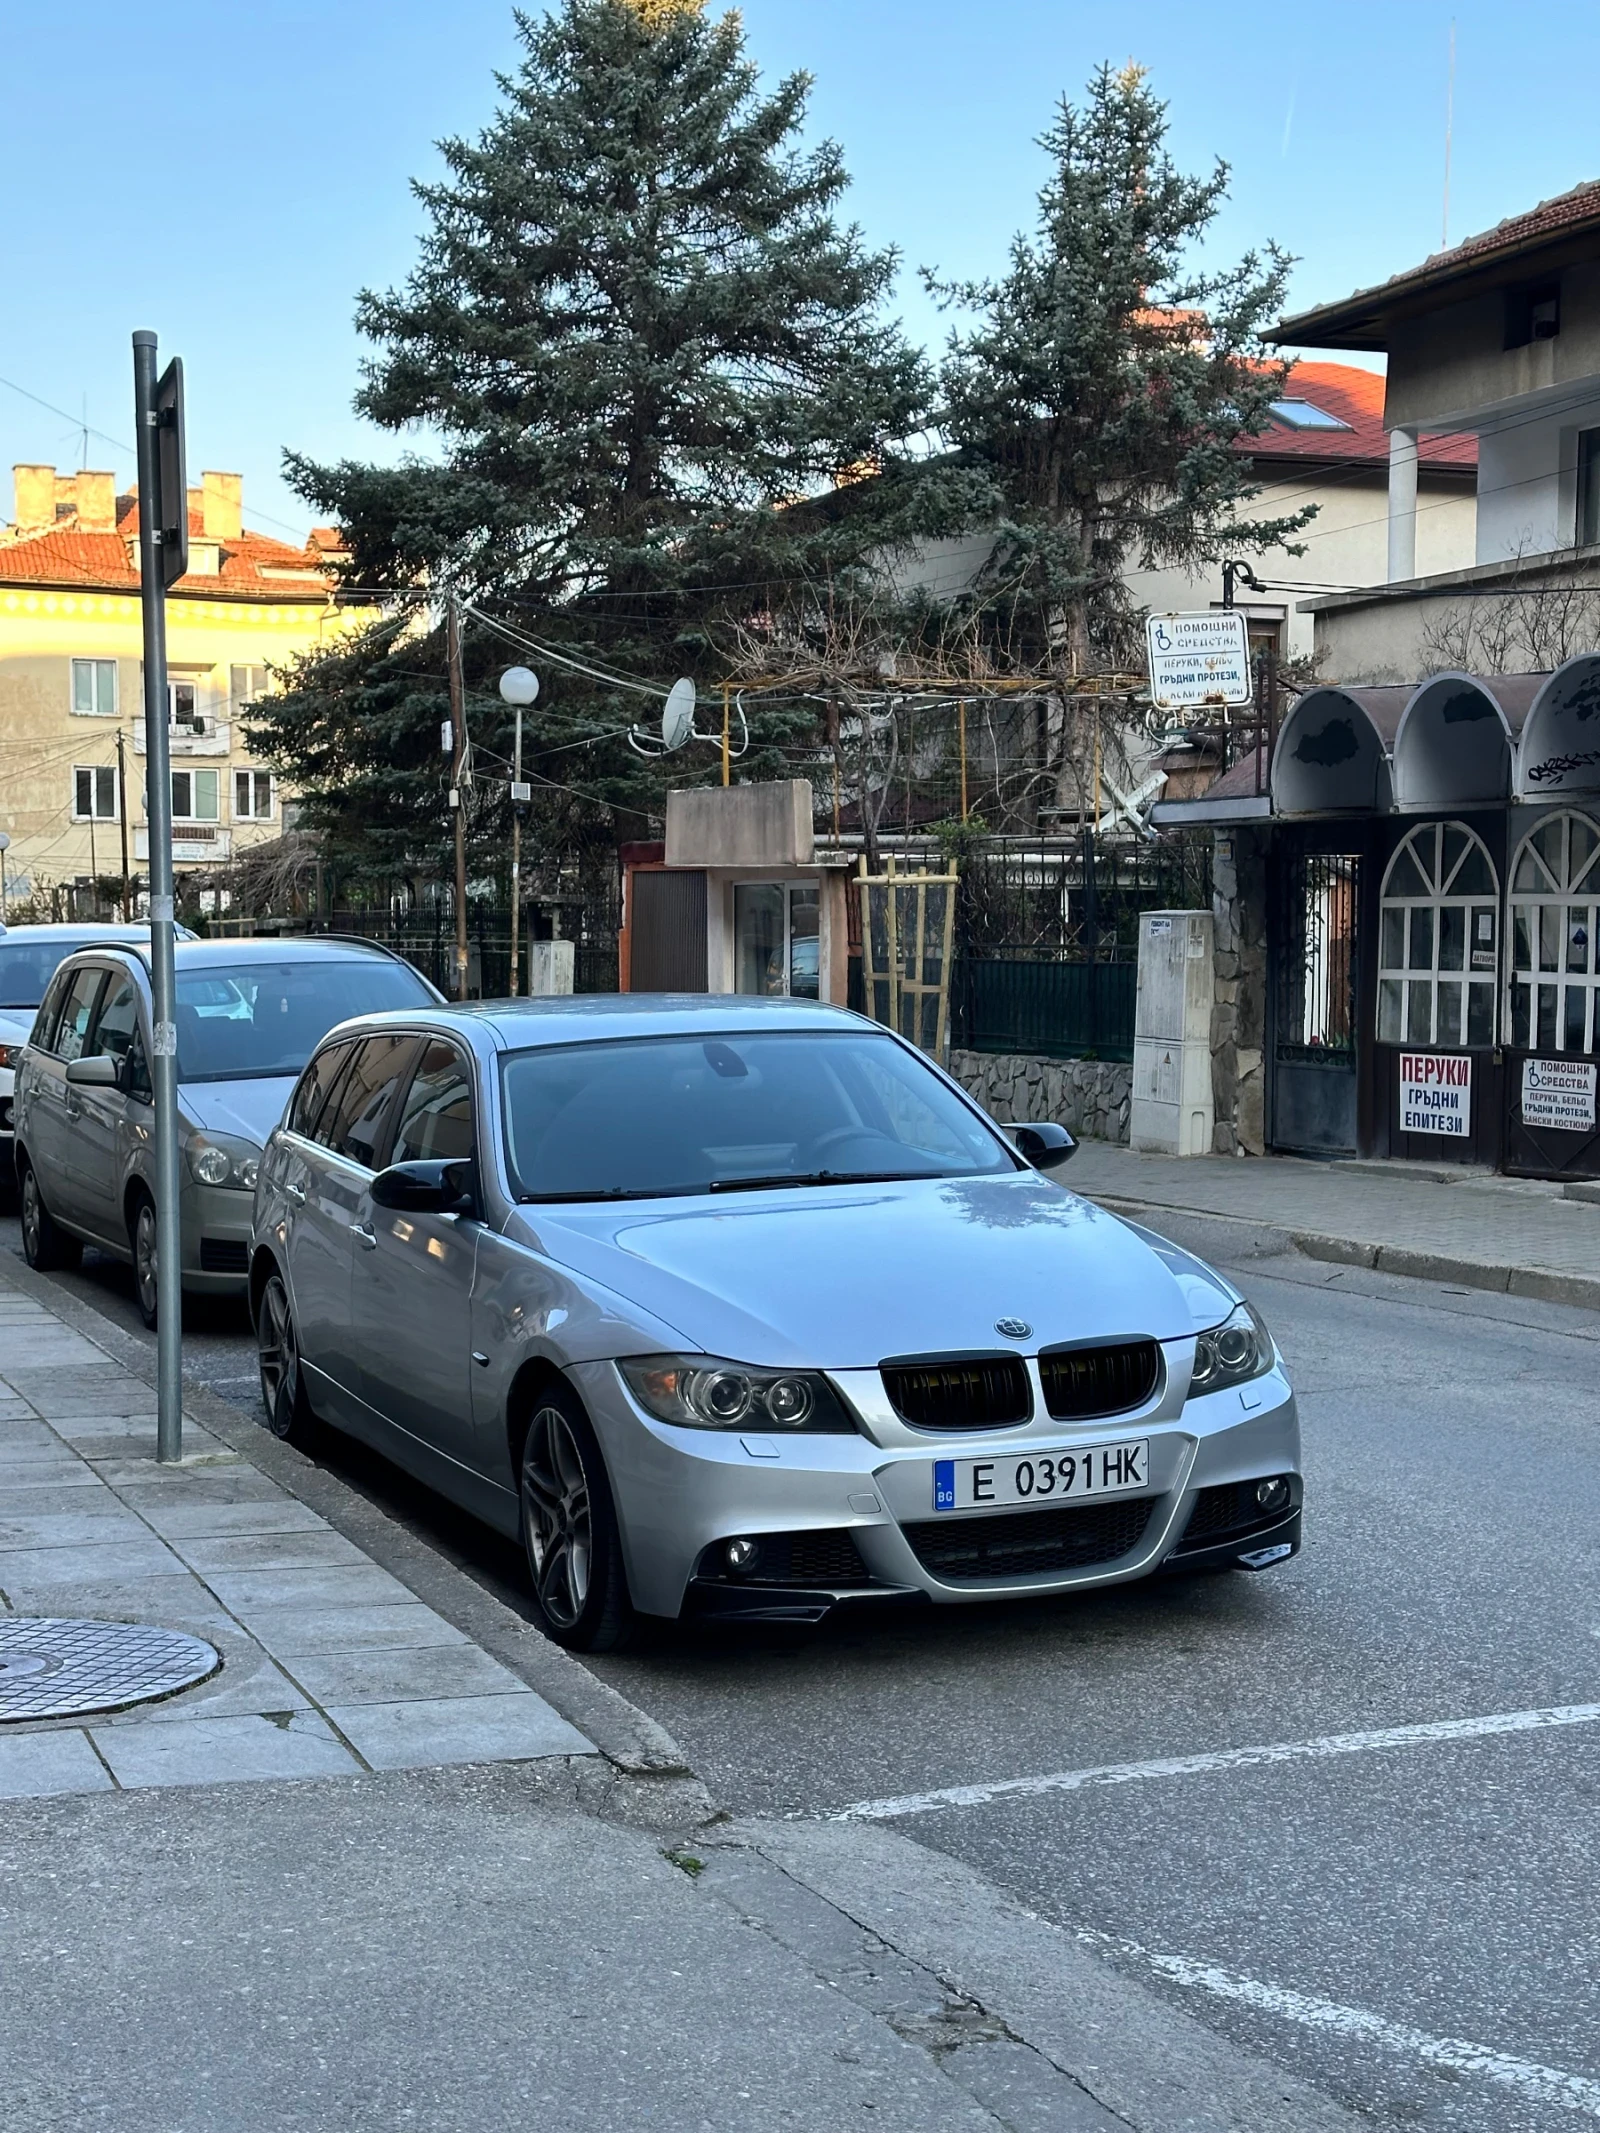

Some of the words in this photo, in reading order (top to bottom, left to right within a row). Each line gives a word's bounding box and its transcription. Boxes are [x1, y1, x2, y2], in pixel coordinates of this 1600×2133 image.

[1160, 673, 1195, 684] ГРЪДНИ
[1197, 670, 1240, 682] ПРОТЕЗИ,
[1473, 954, 1495, 963] ЗАТВОРЕ
[1402, 1056, 1468, 1087] ПЕРУКИ
[1540, 1062, 1590, 1075] ПОМОЩНИ
[1541, 1076, 1589, 1090] СРЕДСТВА
[1408, 1088, 1459, 1110] ГРЪДНИ
[1529, 1092, 1560, 1105] ПЕРУКИ,
[1562, 1096, 1587, 1106] БЕЛЬО
[1524, 1103, 1553, 1114] ГРЪДНИ
[1555, 1106, 1592, 1119] ПРОТЕЗИ,
[1405, 1111, 1463, 1133] ЕПИТЕЗИ
[1523, 1115, 1552, 1126] БАНСКИ
[973, 1463, 995, 1501] E
[937, 1491, 953, 1502] BG
